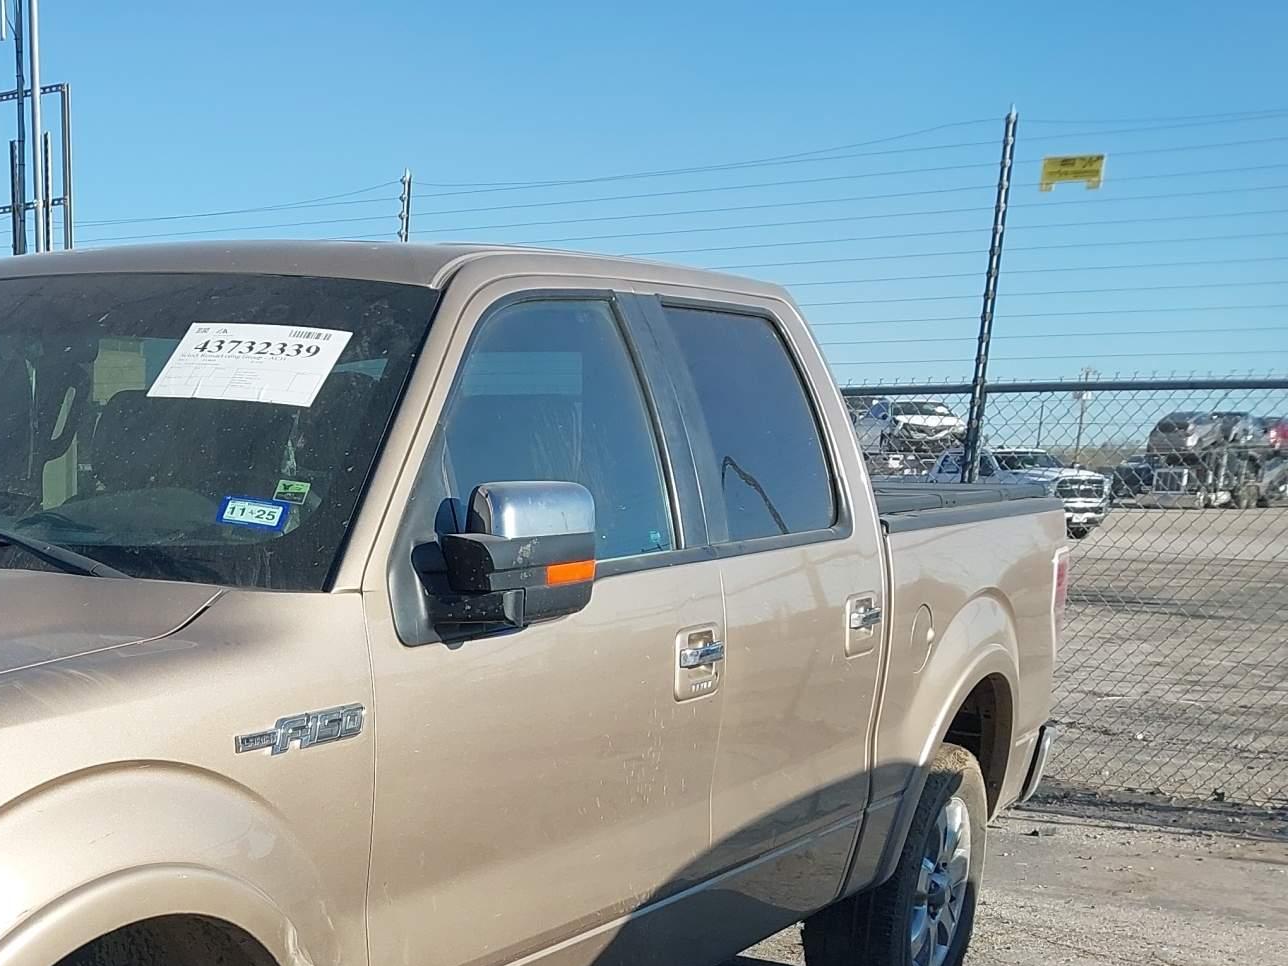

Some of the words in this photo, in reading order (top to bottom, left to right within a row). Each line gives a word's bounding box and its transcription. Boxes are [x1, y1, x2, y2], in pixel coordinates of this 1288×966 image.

[193, 339, 321, 358] 43732339
[228, 506, 246, 517] 11
[255, 509, 277, 521] 25
